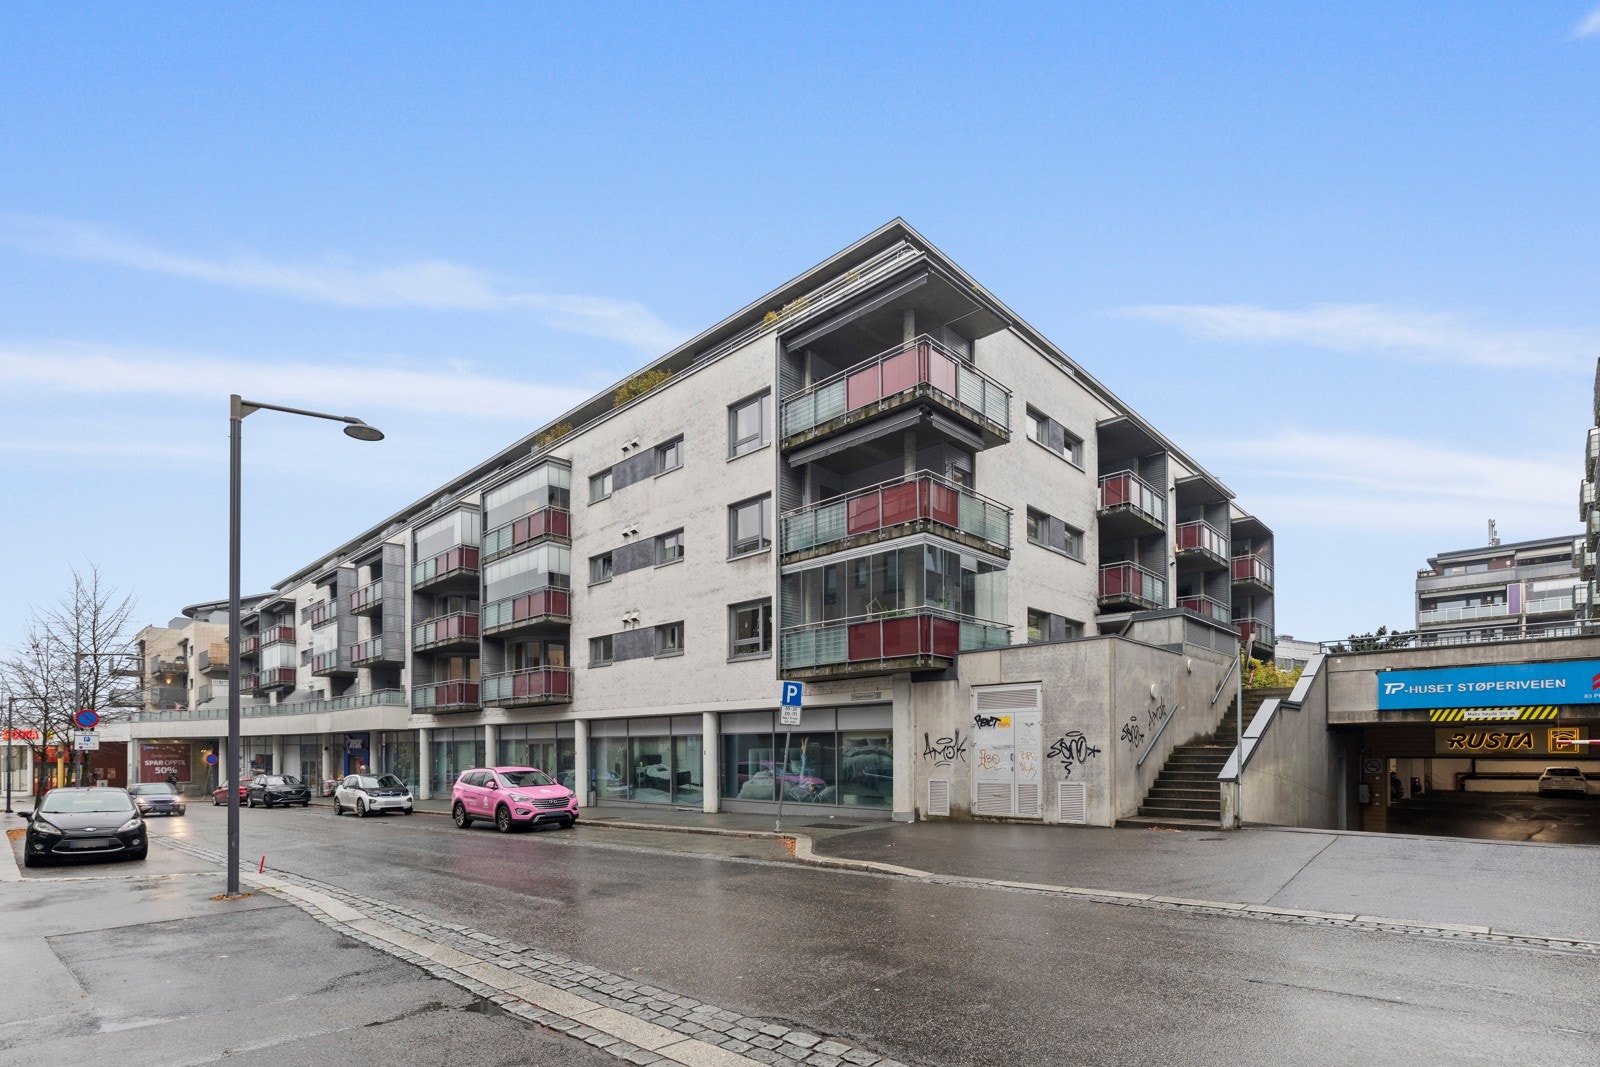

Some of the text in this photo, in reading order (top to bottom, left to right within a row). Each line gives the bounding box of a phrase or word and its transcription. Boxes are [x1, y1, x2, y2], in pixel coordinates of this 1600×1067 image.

[1457, 678, 1566, 692] STØPERIVEIEN
[786, 685, 798, 703] P
[1447, 731, 1534, 750] RUSTA
[154, 766, 178, 774] 50%
